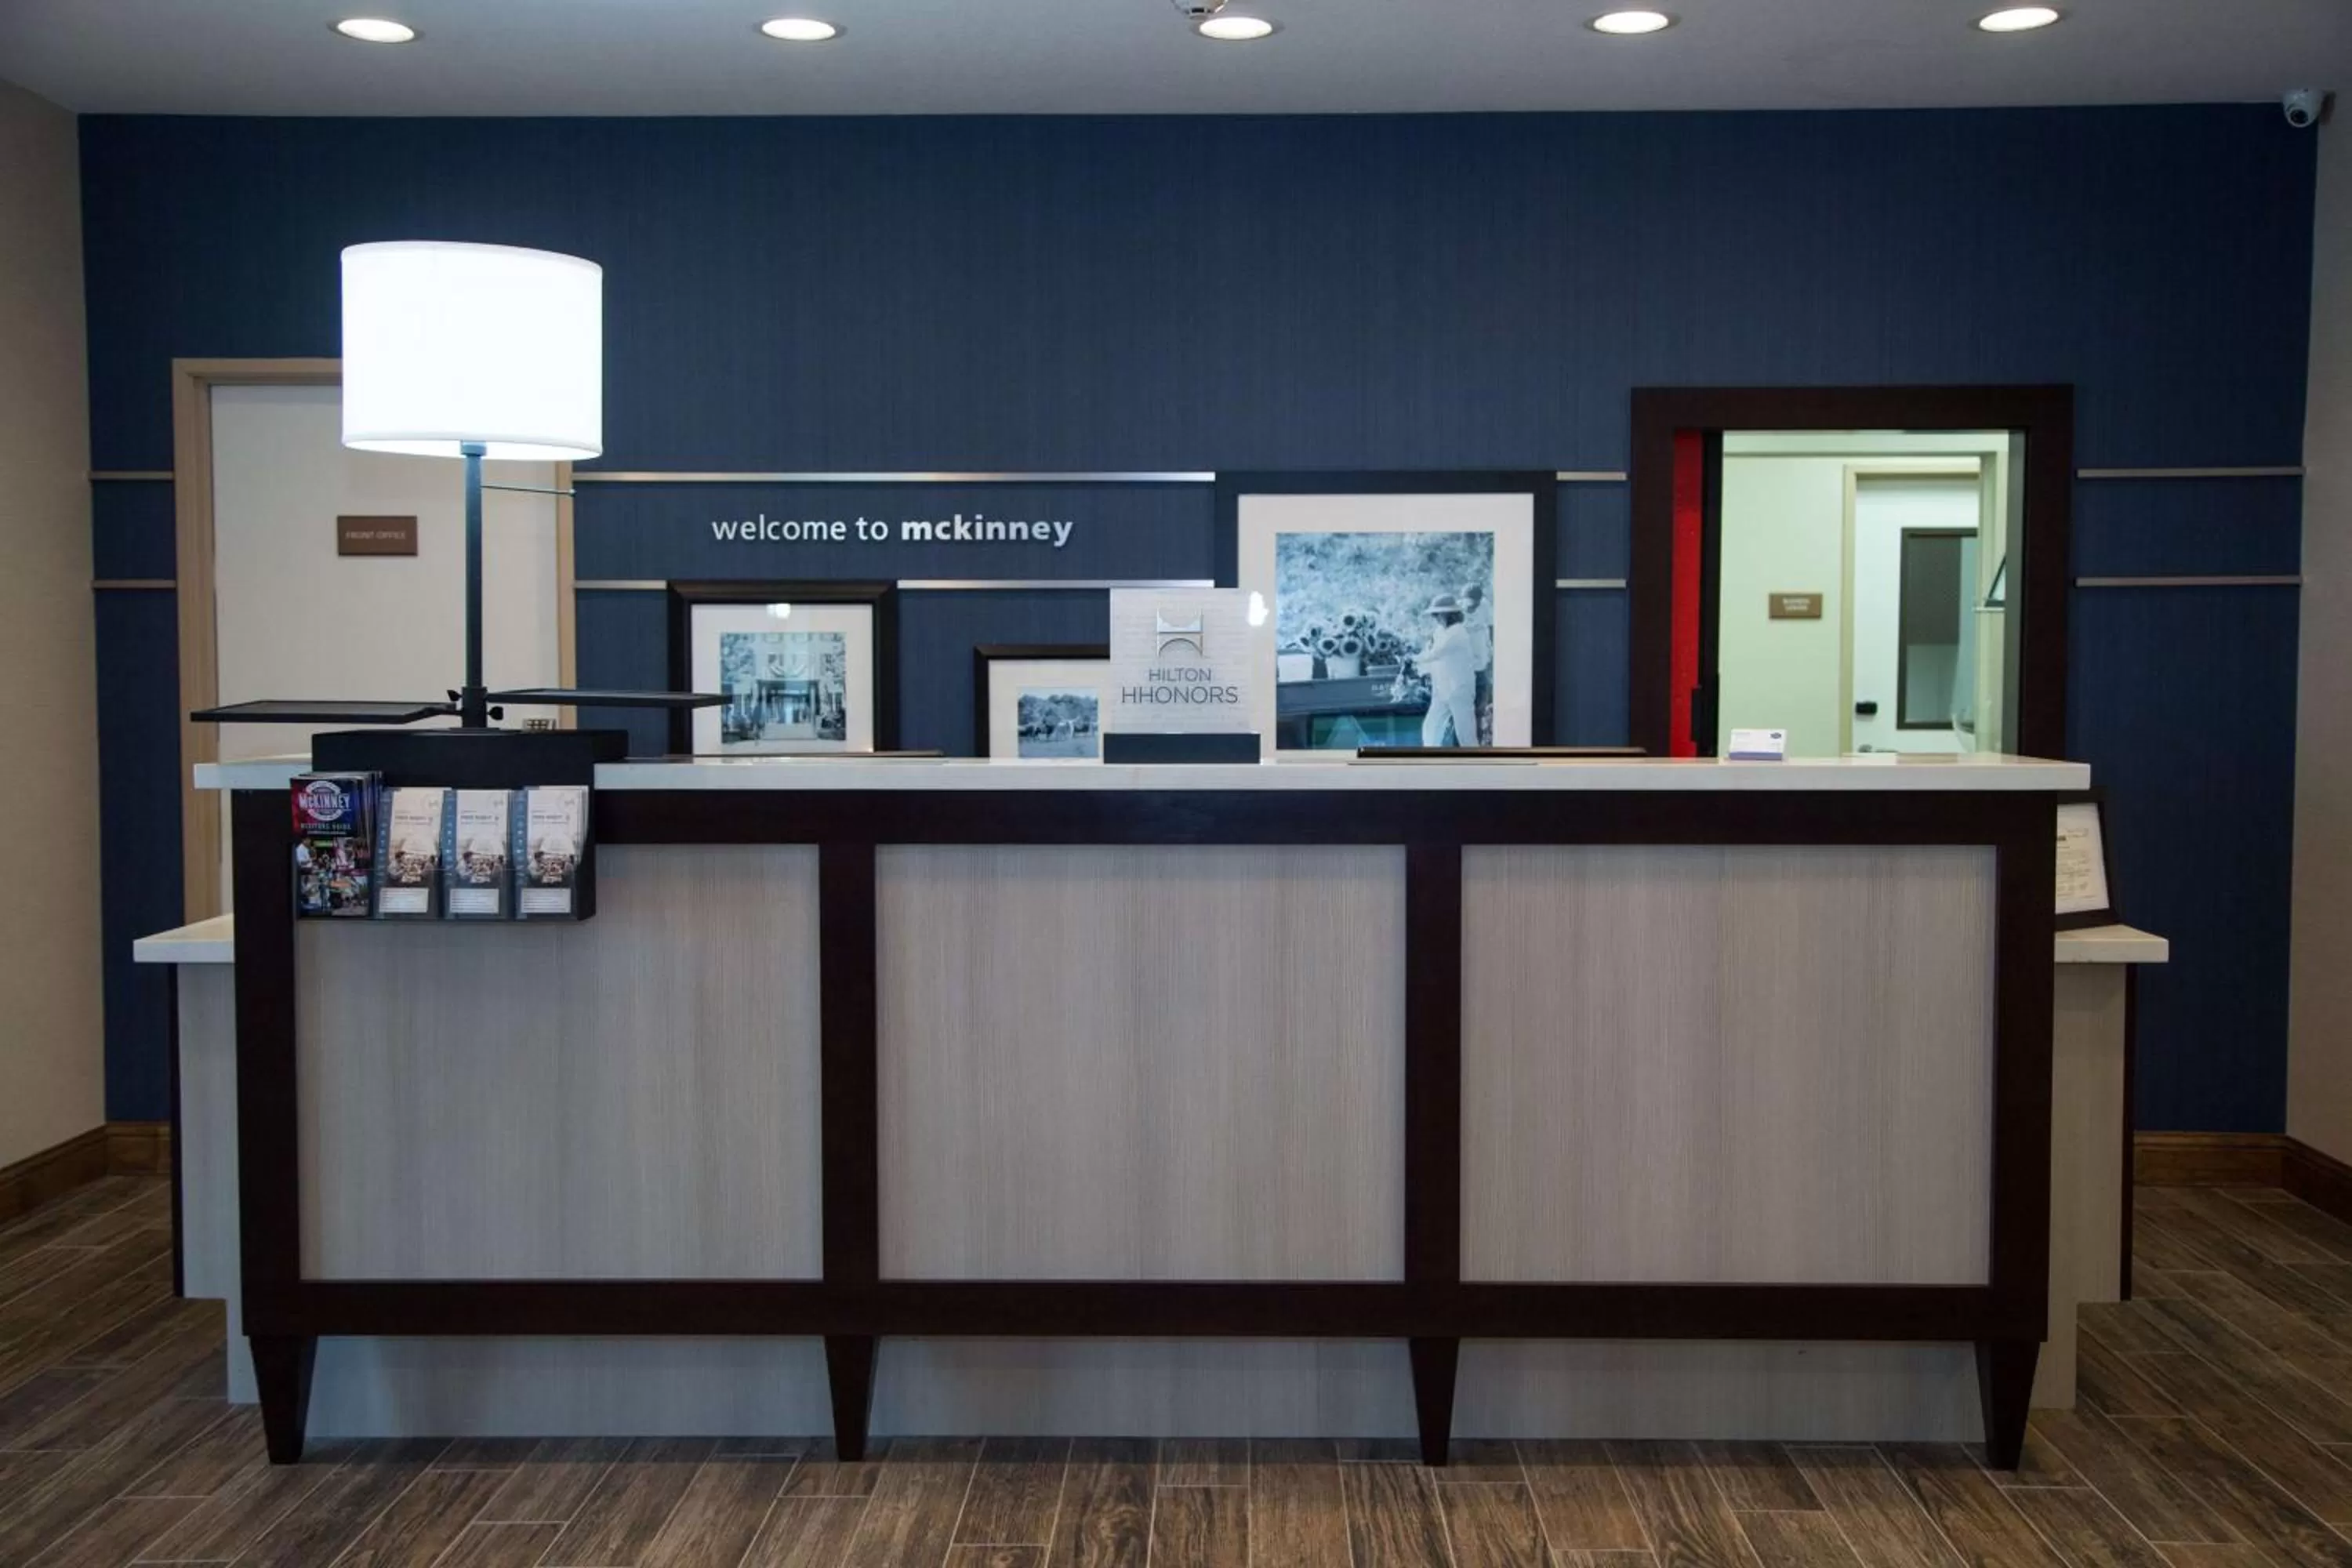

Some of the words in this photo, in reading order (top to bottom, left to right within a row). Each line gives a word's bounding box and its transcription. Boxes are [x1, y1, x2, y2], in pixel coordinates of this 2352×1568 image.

[711, 514, 847, 541] welcome
[855, 517, 888, 541] to
[901, 514, 1073, 546] mckinney
[1149, 667, 1211, 682] HILTON
[1122, 686, 1238, 703] HHONORS
